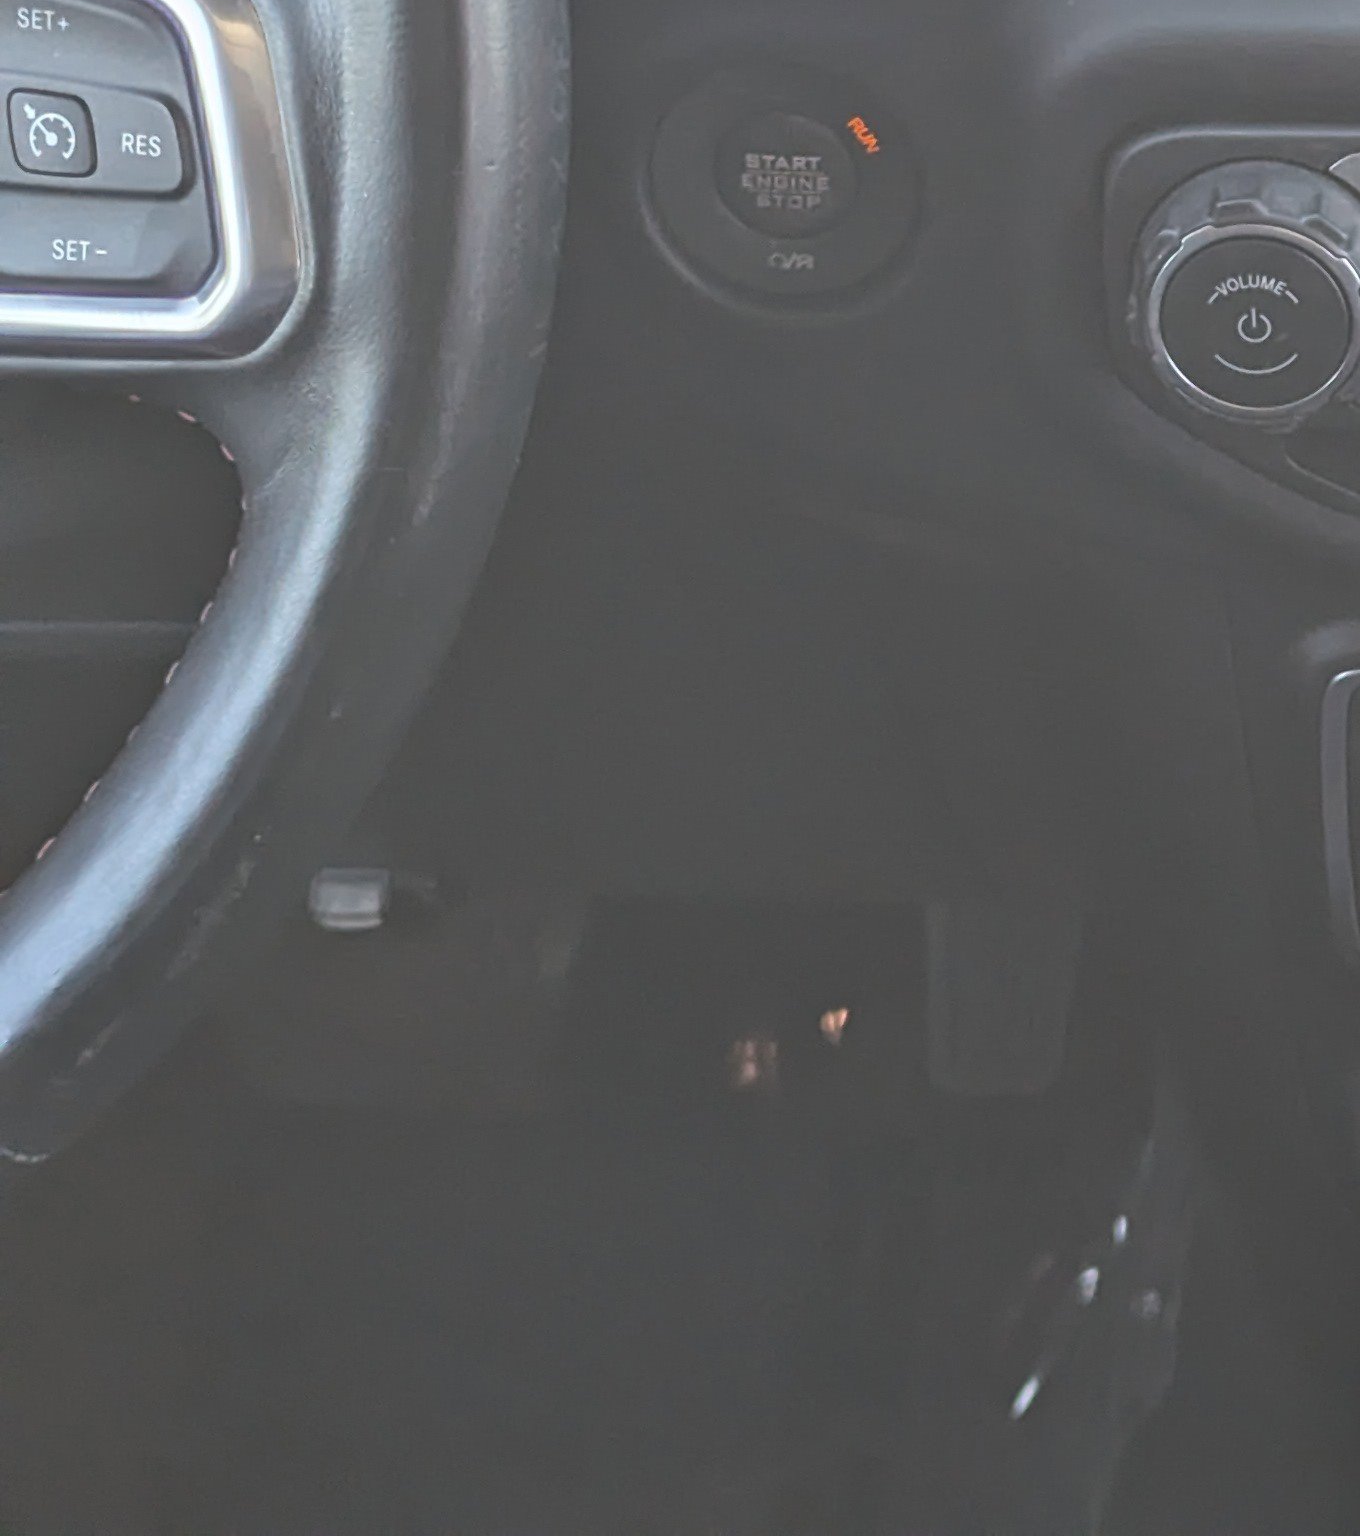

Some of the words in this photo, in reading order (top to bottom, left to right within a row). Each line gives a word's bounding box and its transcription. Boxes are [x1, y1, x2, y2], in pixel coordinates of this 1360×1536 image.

[122, 133, 162, 157] RES
[744, 154, 822, 170] START
[741, 174, 829, 191] ENGINE
[757, 193, 822, 208] STOP
[1214, 275, 1288, 297] VOLUME
